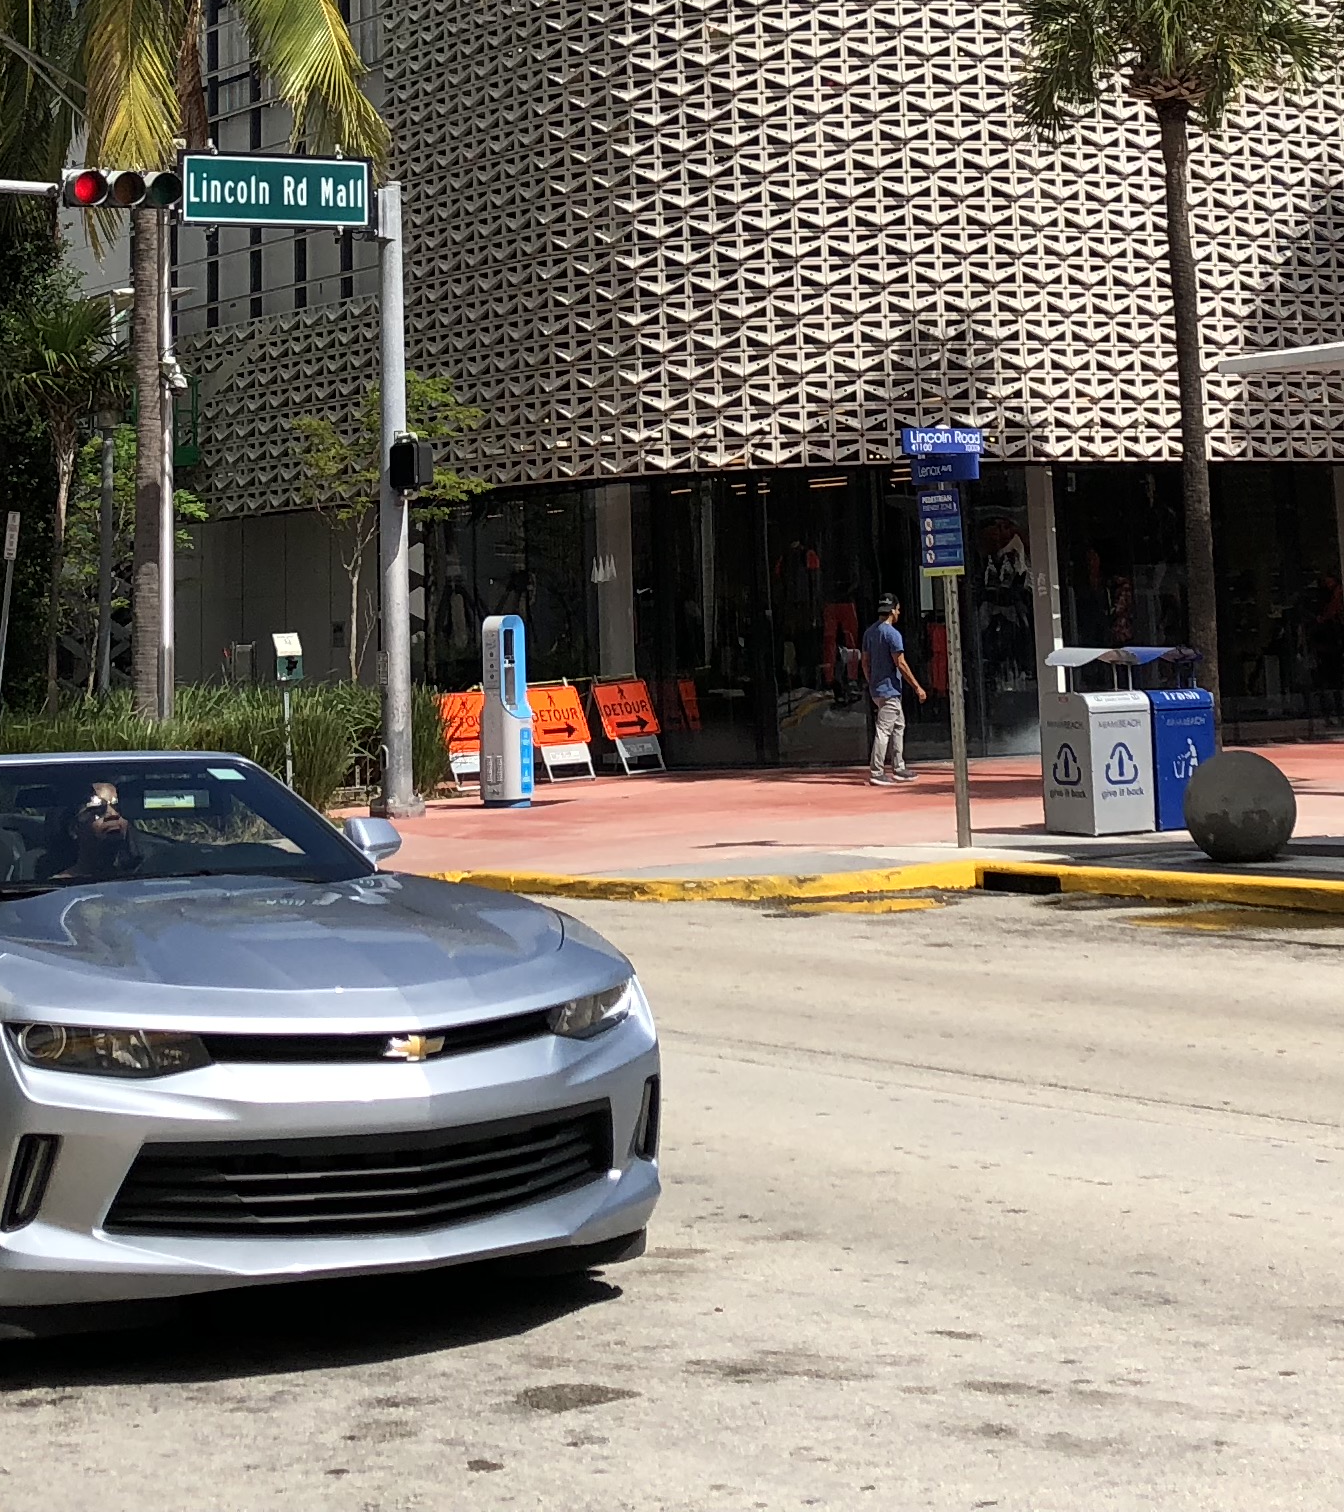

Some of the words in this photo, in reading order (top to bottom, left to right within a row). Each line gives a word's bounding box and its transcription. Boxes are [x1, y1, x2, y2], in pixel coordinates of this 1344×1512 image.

[189, 172, 270, 205] Lincoln
[283, 175, 307, 206] Rd
[320, 176, 363, 208] Mall
[909, 430, 952, 444] Lincoln
[954, 431, 981, 445] Road
[918, 465, 942, 478] Lenox
[1160, 690, 1201, 701] Trash
[603, 699, 649, 718] DETOUR
